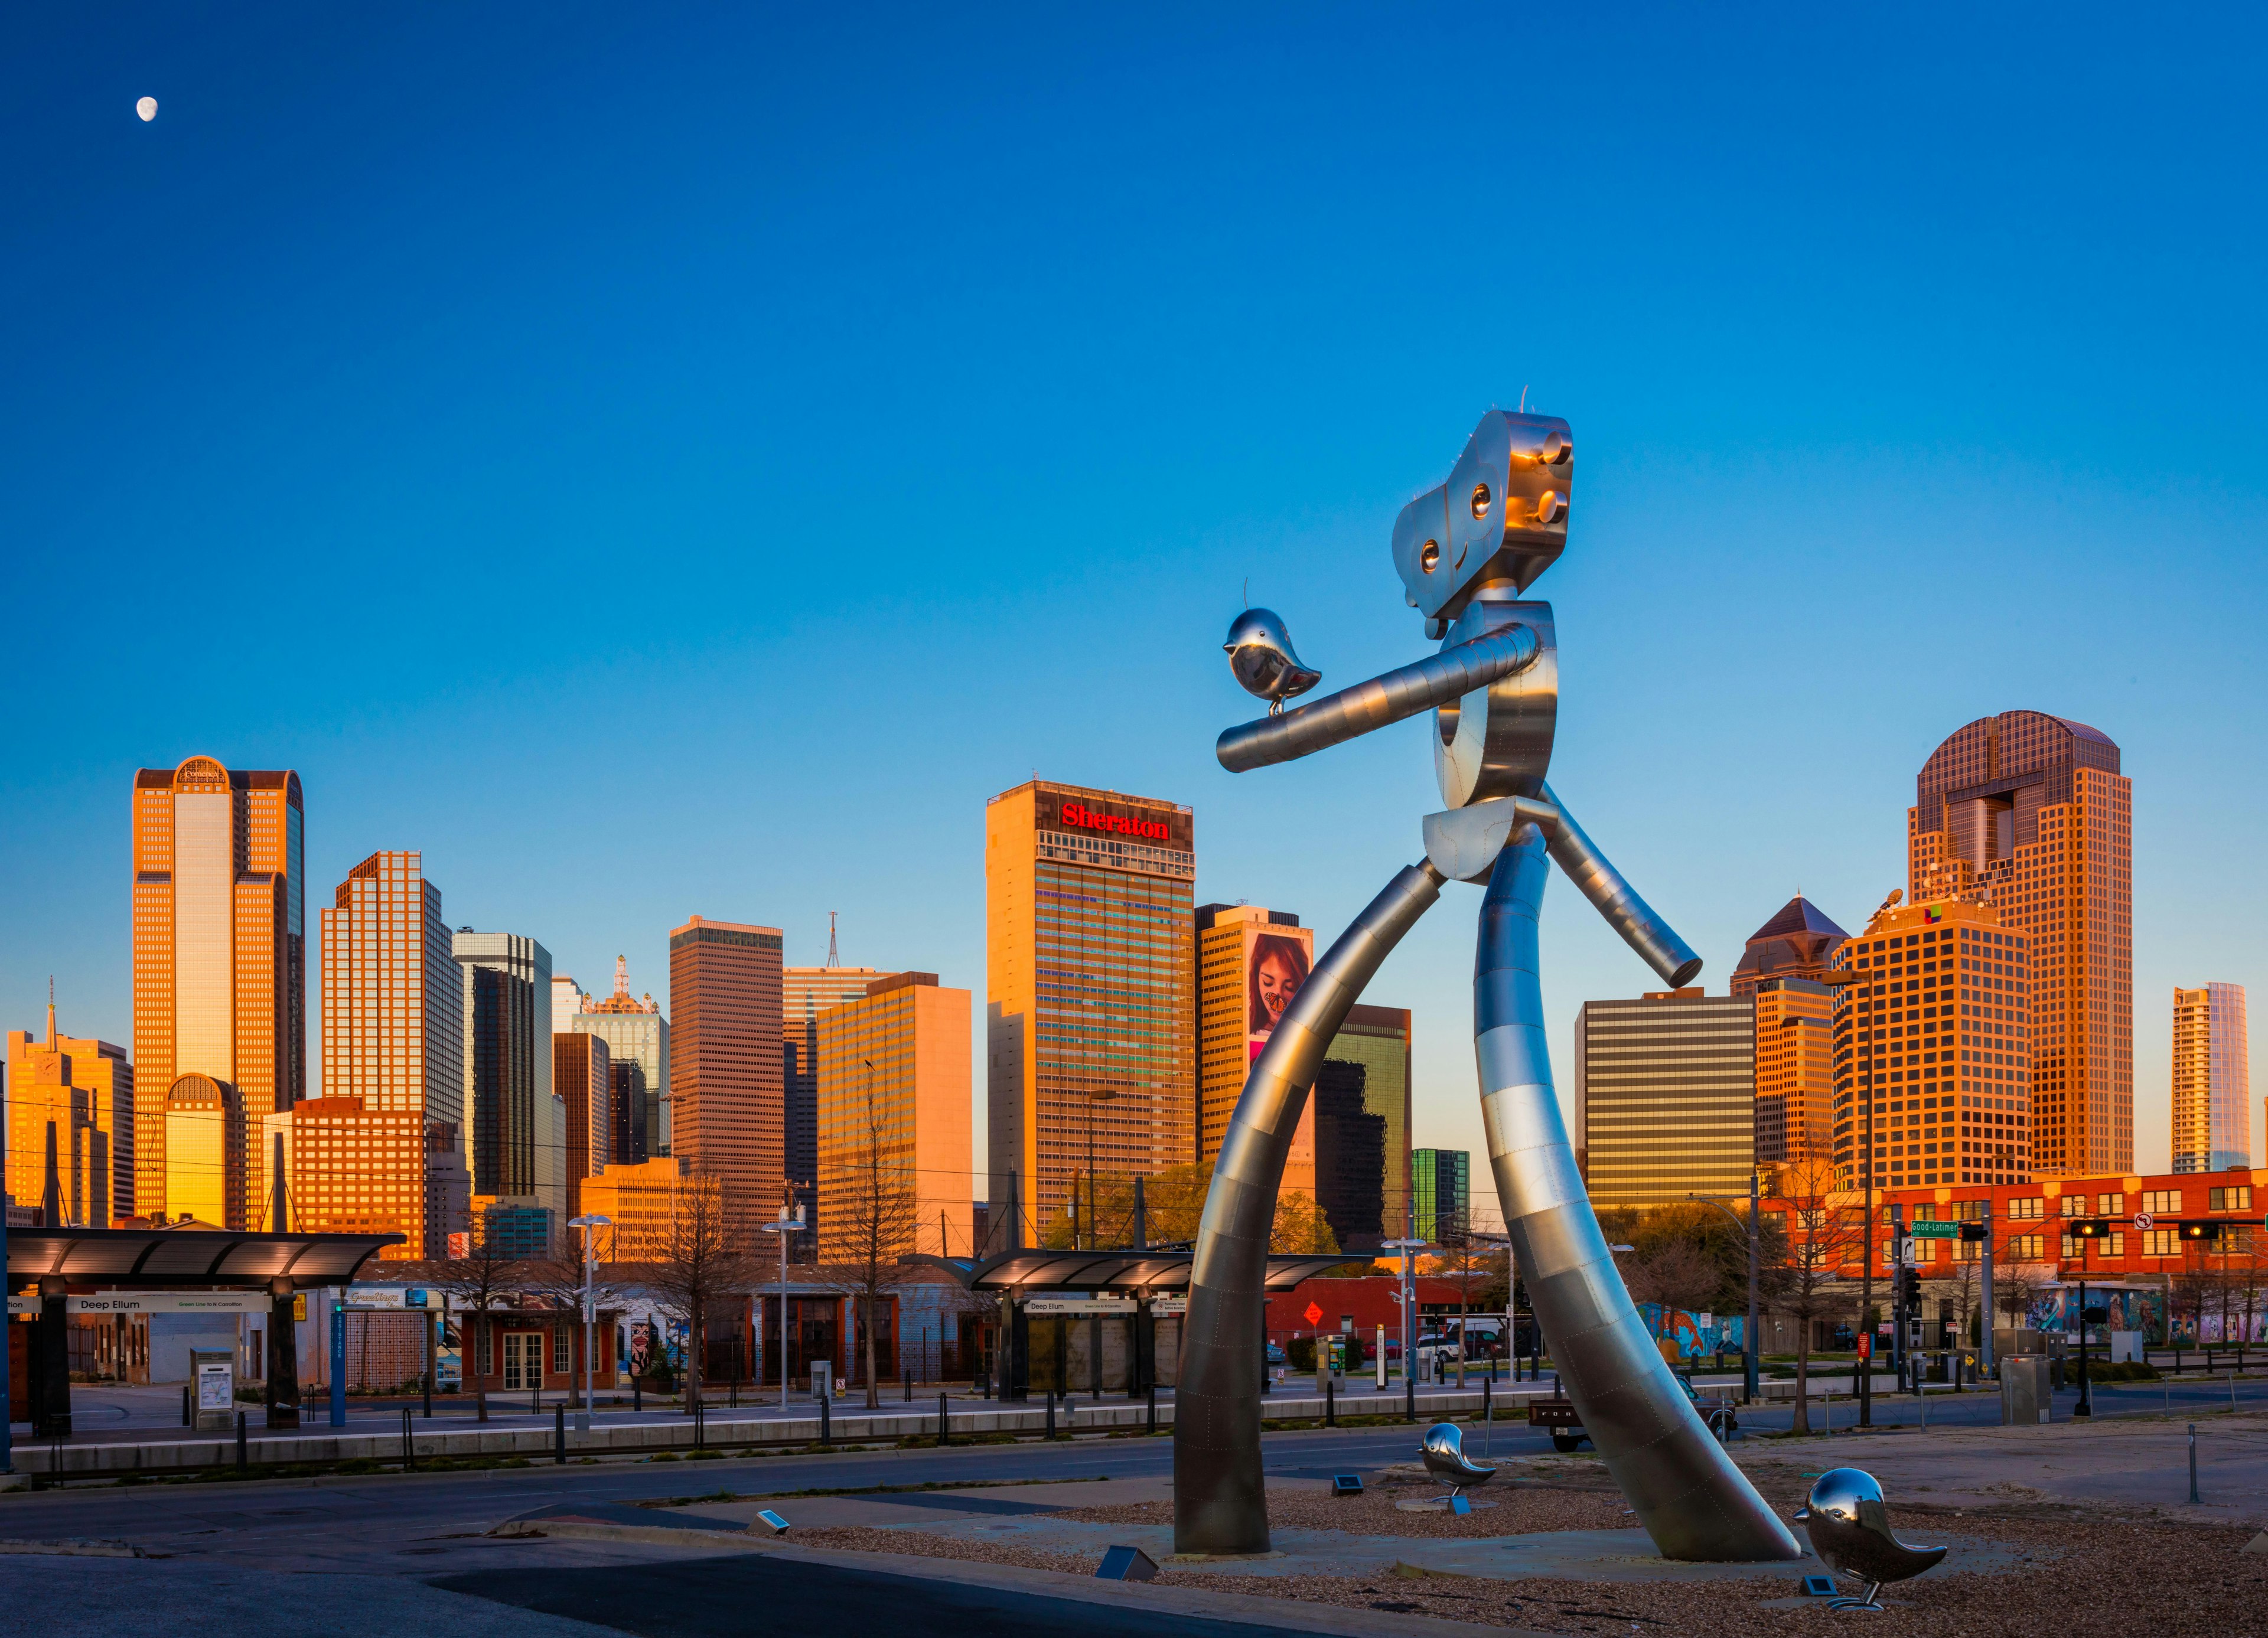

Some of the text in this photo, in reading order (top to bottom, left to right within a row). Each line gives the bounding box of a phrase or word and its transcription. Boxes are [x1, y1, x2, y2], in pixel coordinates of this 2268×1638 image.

[1063, 803, 1169, 840] Sheraton
[1912, 1222, 1957, 1232] Good-Latimer
[81, 1300, 140, 1310] Deep Ellum
[350, 1291, 399, 1307] Greetings
